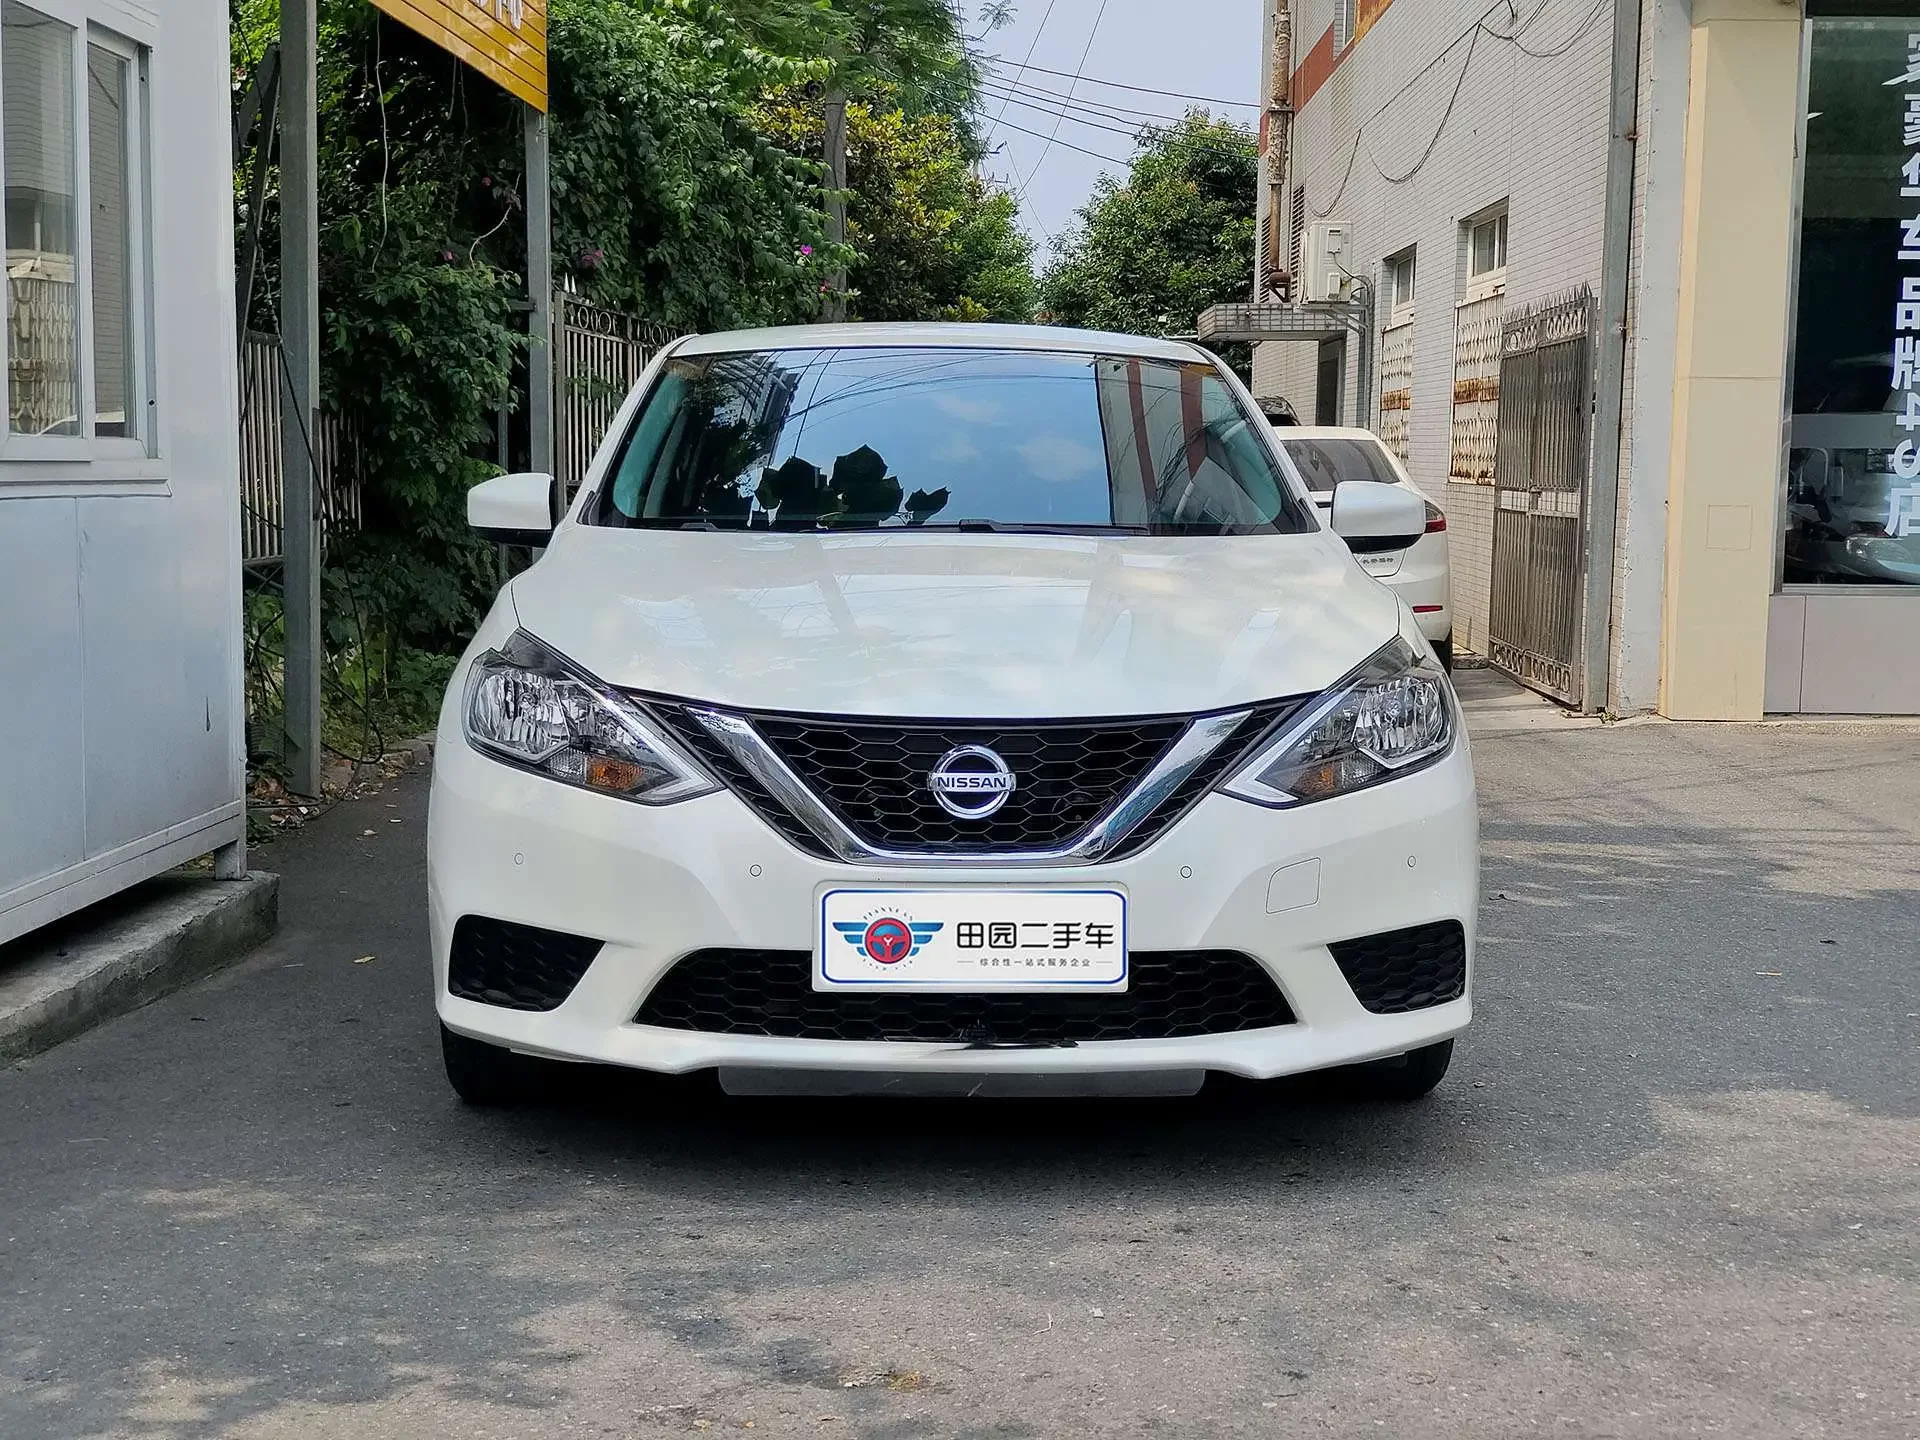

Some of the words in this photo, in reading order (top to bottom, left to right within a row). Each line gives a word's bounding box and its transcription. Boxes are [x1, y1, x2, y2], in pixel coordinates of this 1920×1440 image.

[936, 776, 1007, 788] NISSAN
[956, 922, 1115, 950] 田园二手车
[979, 958, 1091, 968] 综合性一站式服务企业
